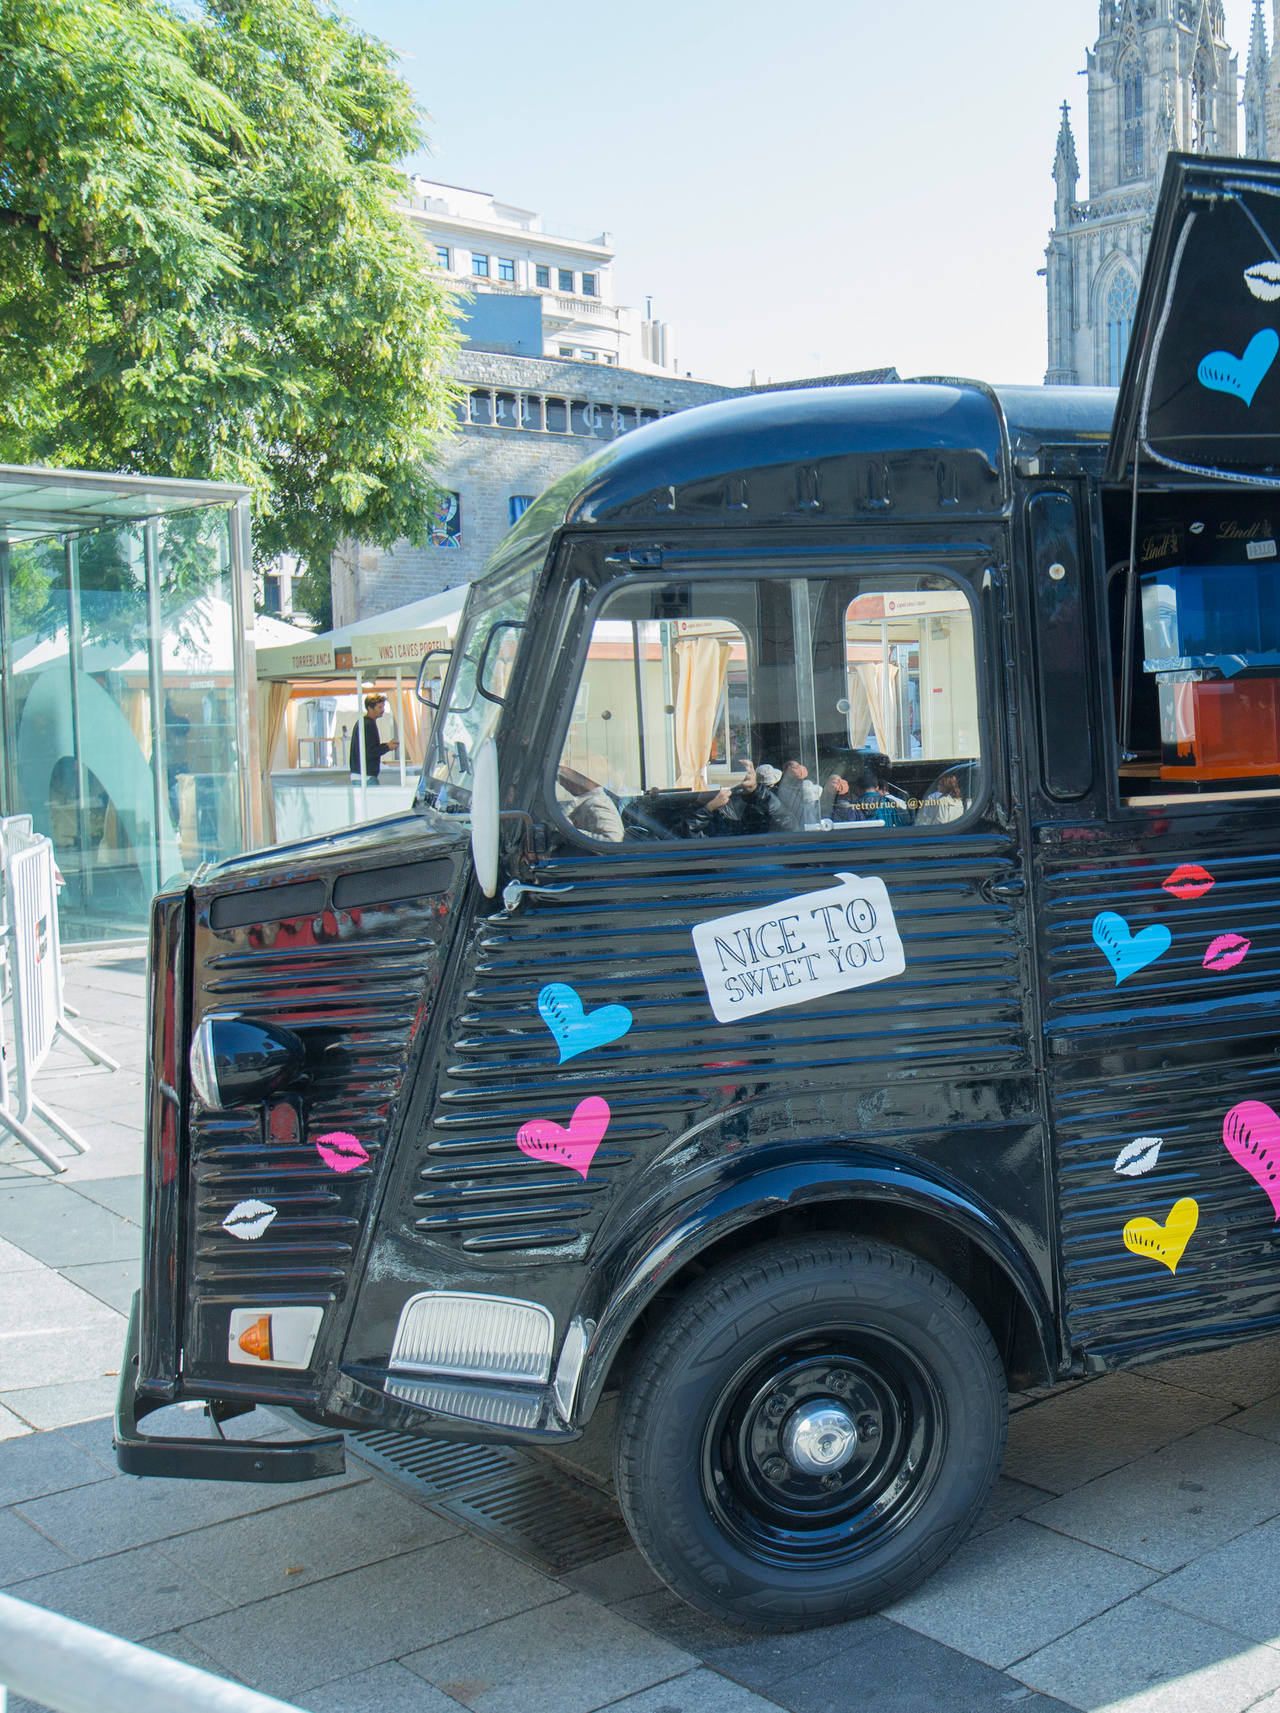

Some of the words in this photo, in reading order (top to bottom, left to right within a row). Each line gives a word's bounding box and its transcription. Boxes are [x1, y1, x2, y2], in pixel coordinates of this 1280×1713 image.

[1216, 521, 1261, 539] Lindt
[1141, 533, 1169, 561] Lindt
[1249, 542, 1275, 557] HELLO
[379, 645, 394, 659] VINS
[394, 645, 398, 658] I
[398, 643, 418, 658] CAVES
[292, 652, 332, 669] TORREBLANCA
[713, 914, 806, 972] NICE
[810, 898, 877, 943] TO
[724, 952, 821, 1003] SWEET
[828, 936, 885, 974] YOU
